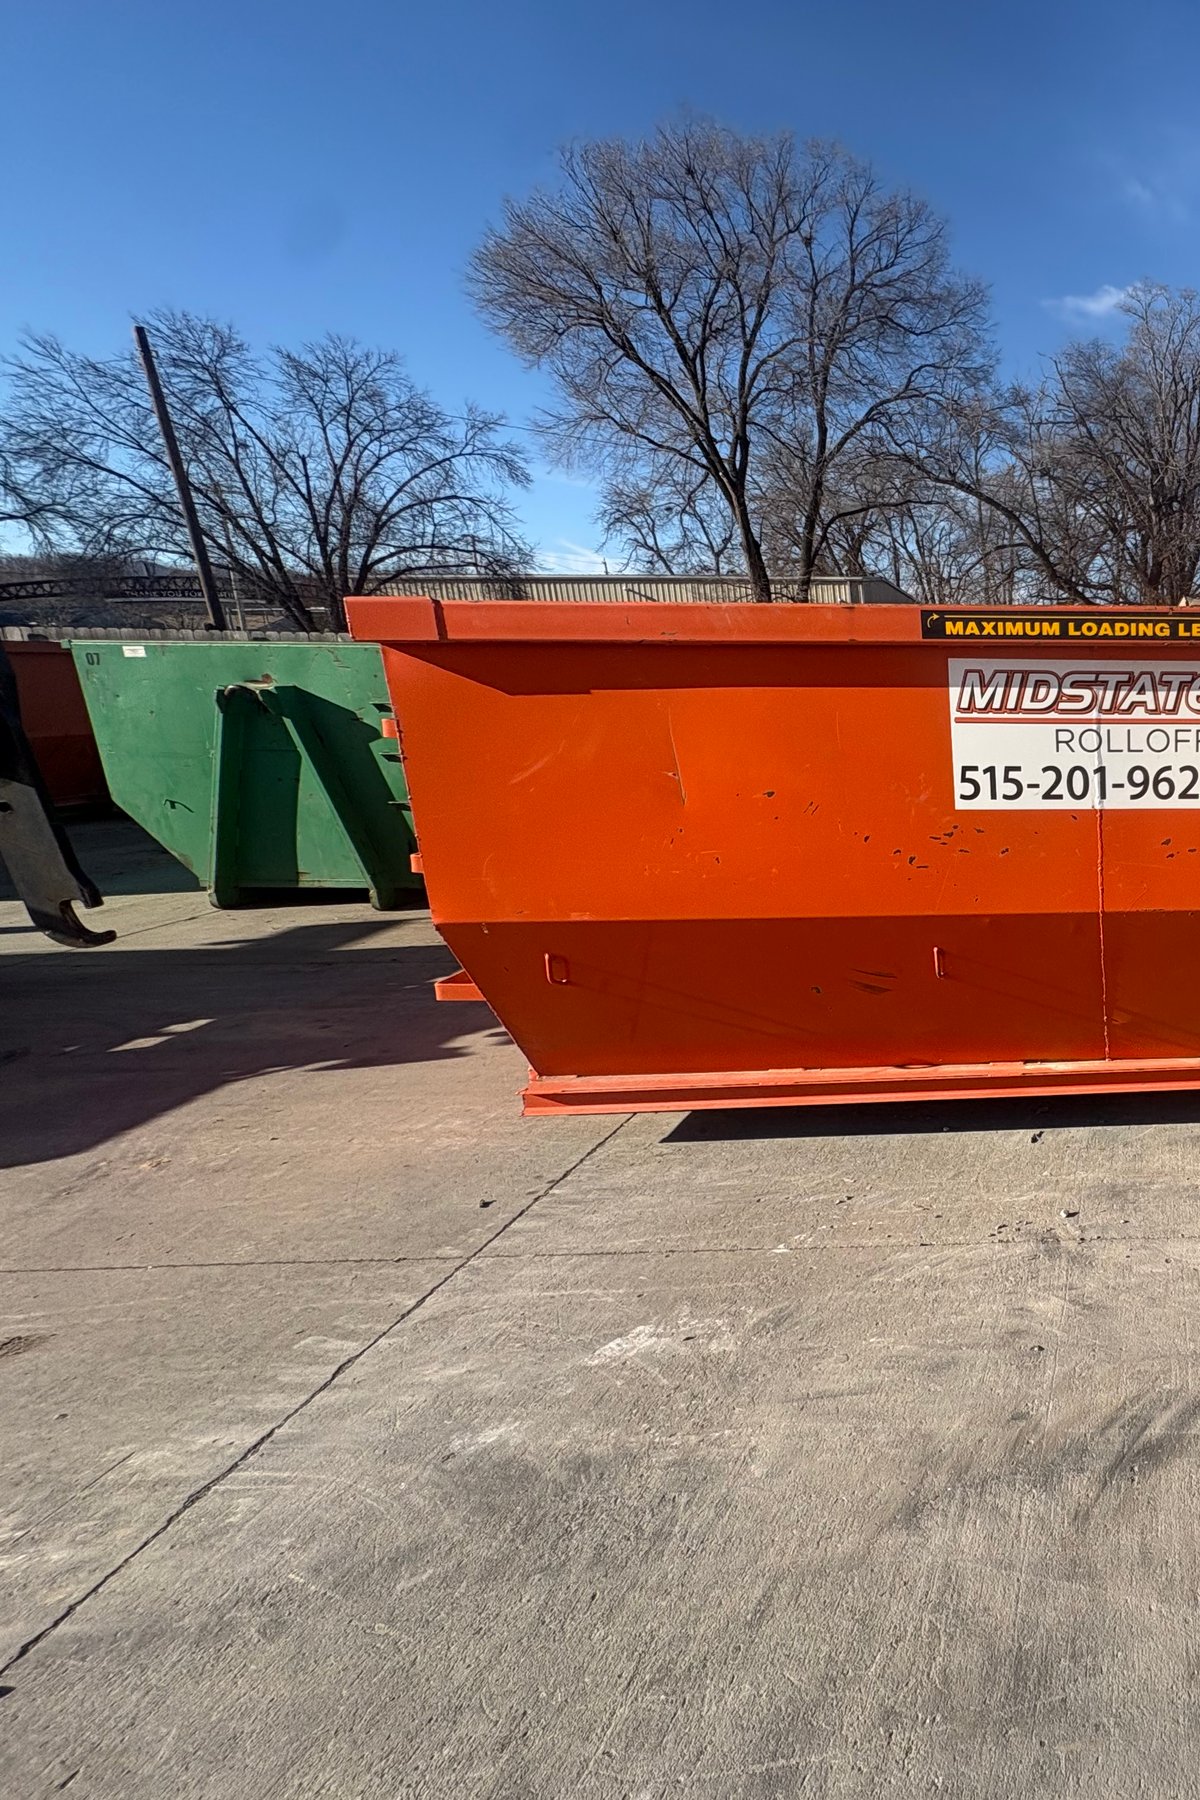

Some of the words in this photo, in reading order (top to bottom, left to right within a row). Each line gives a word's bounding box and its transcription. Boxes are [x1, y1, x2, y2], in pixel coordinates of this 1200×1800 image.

[945, 621, 1060, 637] MAXIMUM
[1068, 622, 1170, 637] LOADING
[85, 652, 101, 666] 07
